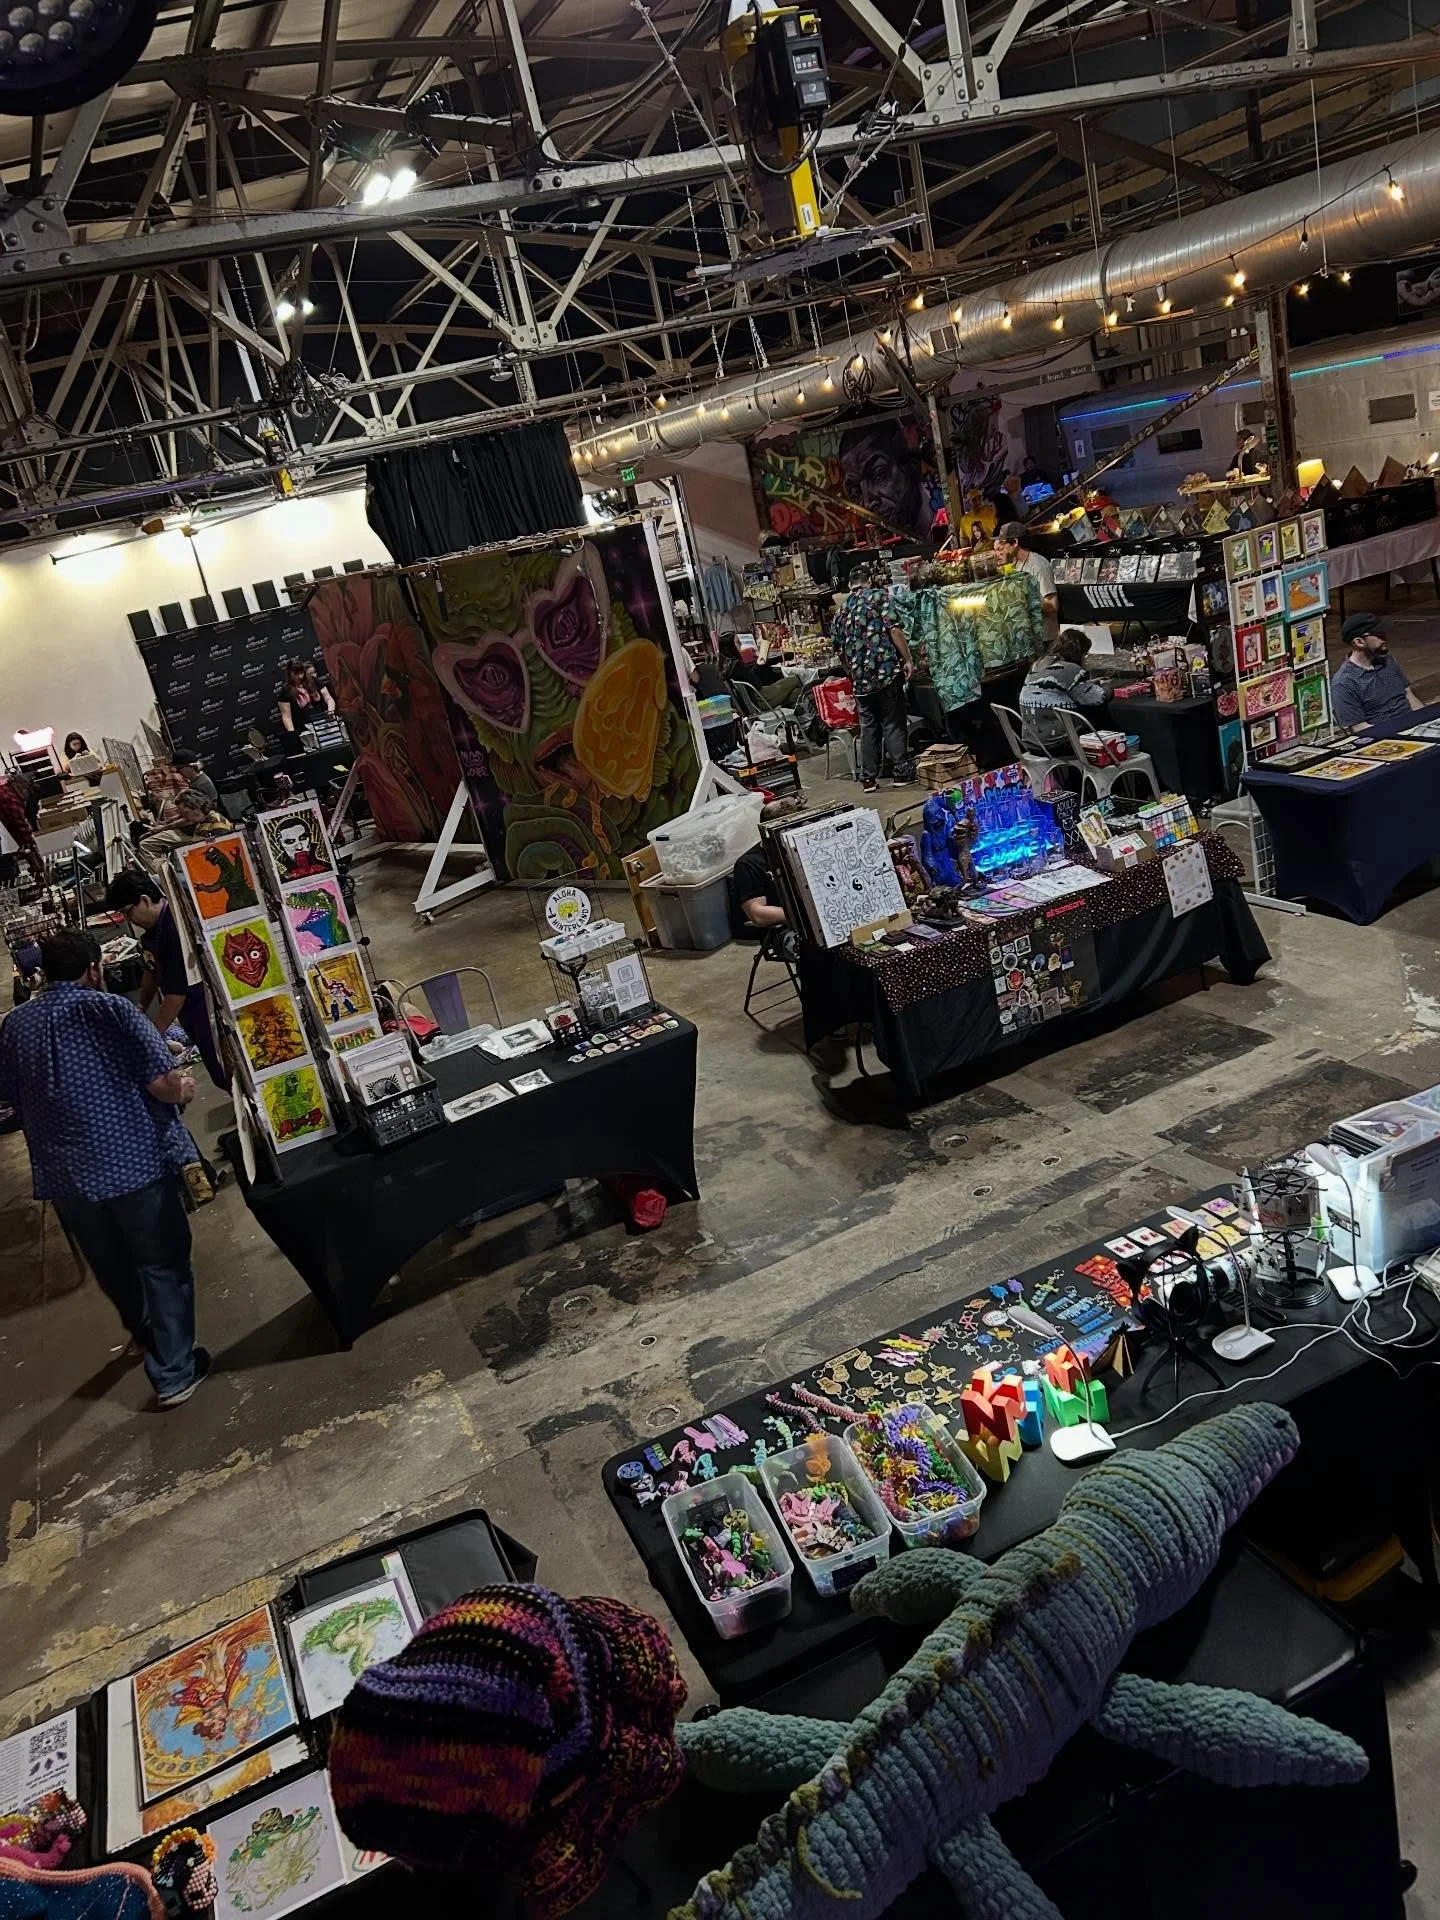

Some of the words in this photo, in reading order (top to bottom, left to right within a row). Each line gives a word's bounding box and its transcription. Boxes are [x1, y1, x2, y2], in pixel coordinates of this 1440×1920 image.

[1083, 584, 1135, 609] VINYL
[552, 889, 577, 903] ALOHA
[551, 908, 589, 932] HINTERLAND
